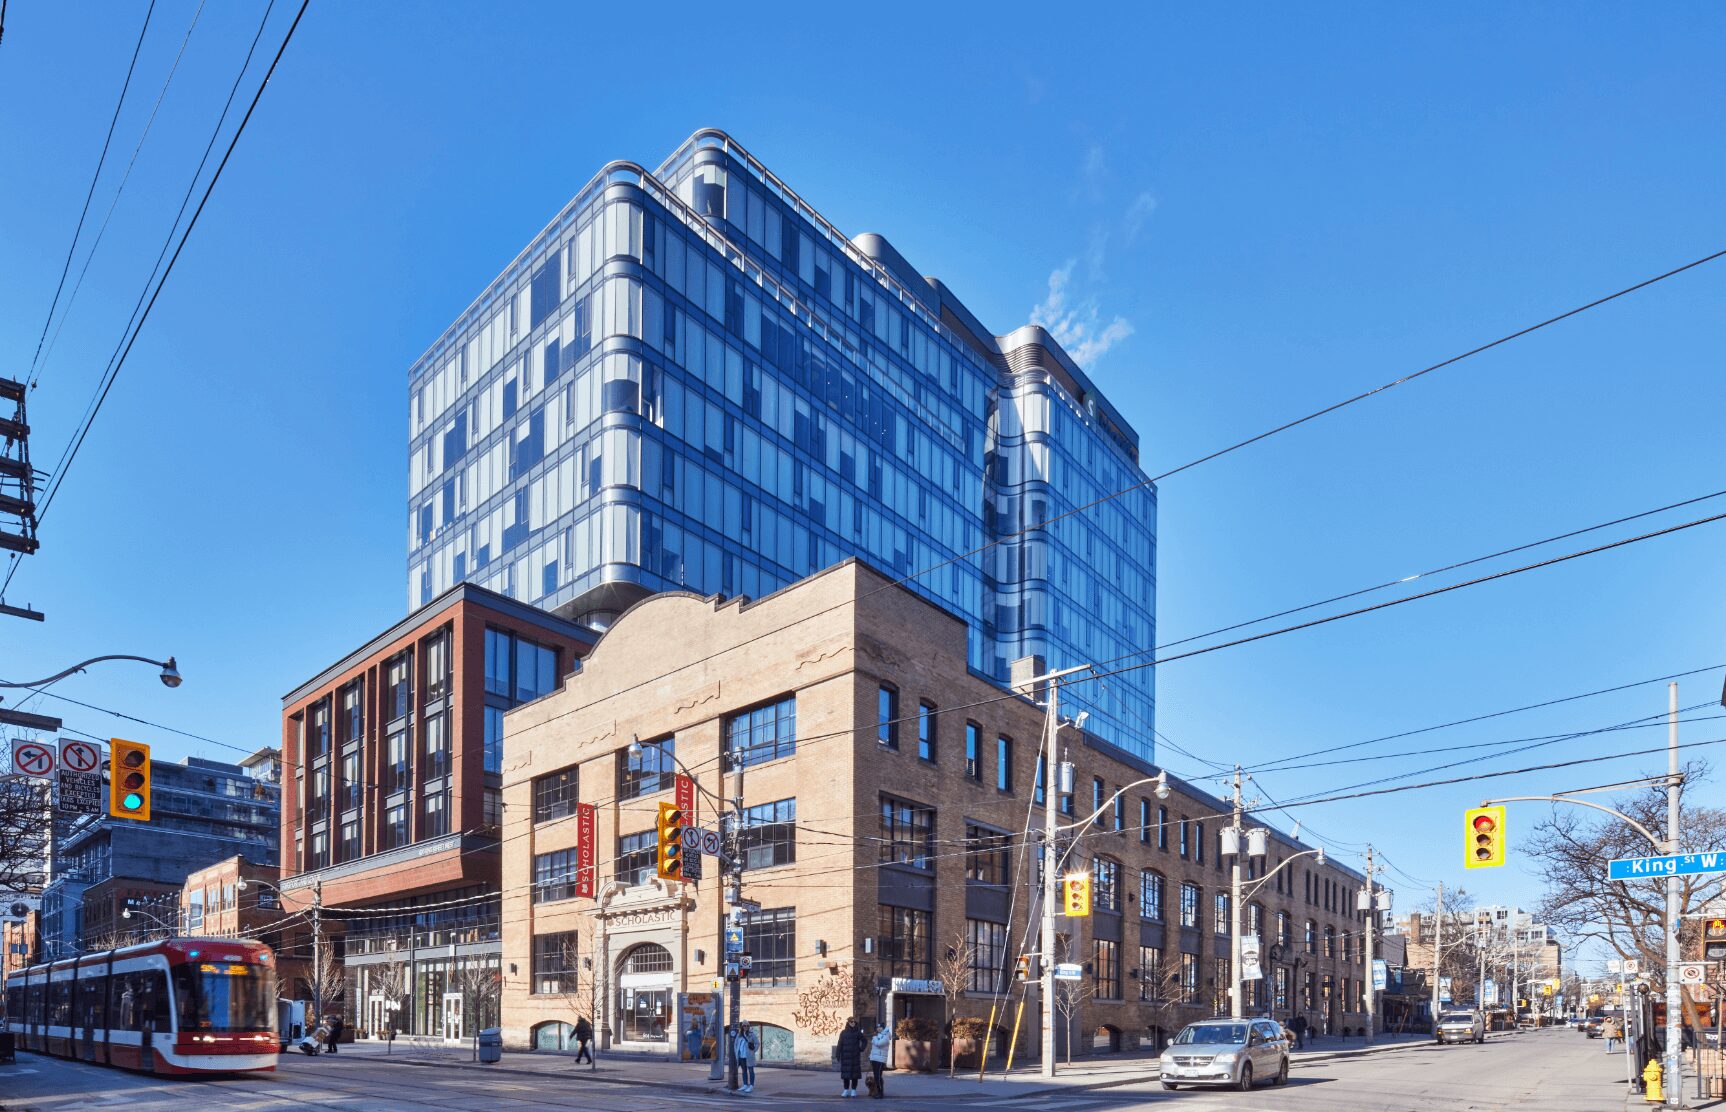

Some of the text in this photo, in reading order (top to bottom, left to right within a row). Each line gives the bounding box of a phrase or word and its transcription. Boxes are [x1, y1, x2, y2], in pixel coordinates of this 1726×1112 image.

[61, 770, 100, 781] AUTHORIZED
[65, 776, 95, 785] VEHICLES
[60, 782, 100, 793] AND BICYCLES
[64, 790, 96, 799] EXCEPTED
[581, 807, 590, 882] SCHOLASTIC
[1632, 853, 1717, 874] King St W
[615, 910, 675, 926] SCHOLASTIC
